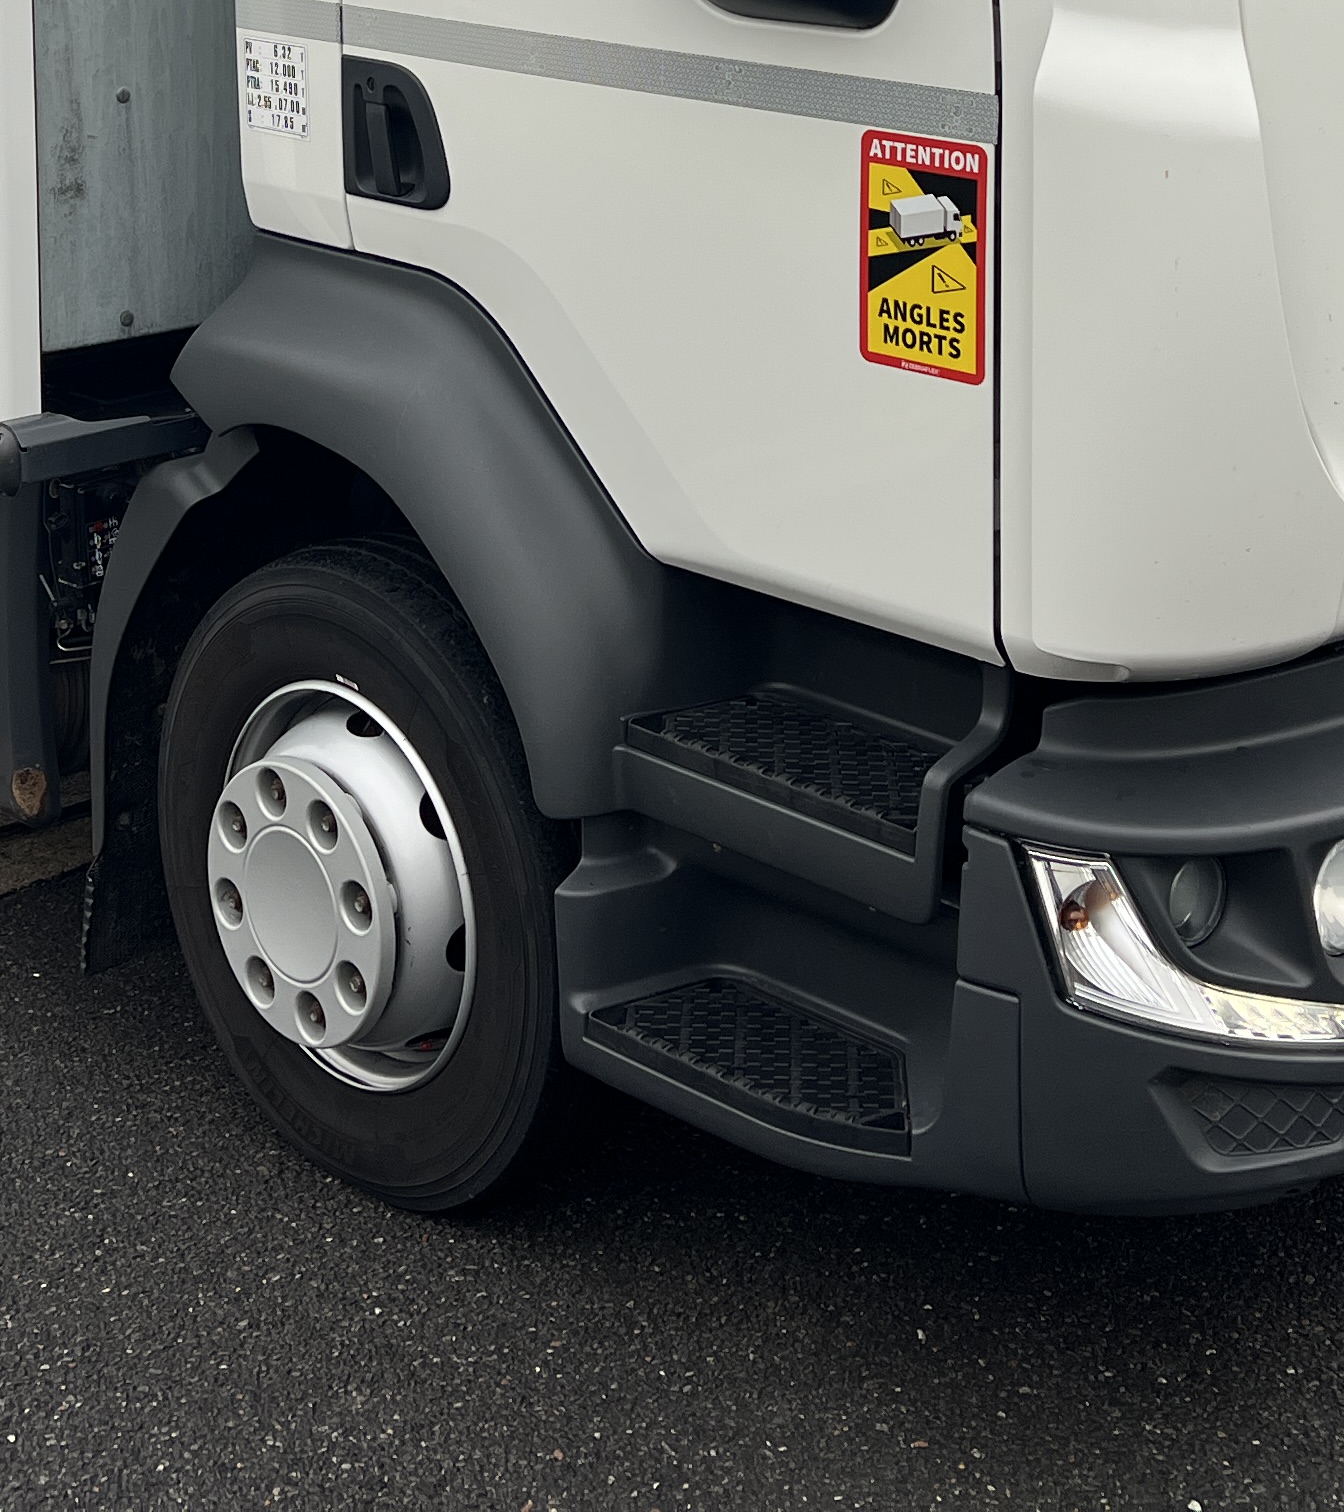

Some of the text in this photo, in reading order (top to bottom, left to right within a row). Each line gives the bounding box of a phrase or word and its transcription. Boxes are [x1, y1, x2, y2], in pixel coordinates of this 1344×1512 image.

[869, 138, 980, 174] ATTENTION
[877, 297, 966, 335] ANGLES
[883, 322, 962, 360] MORTS
